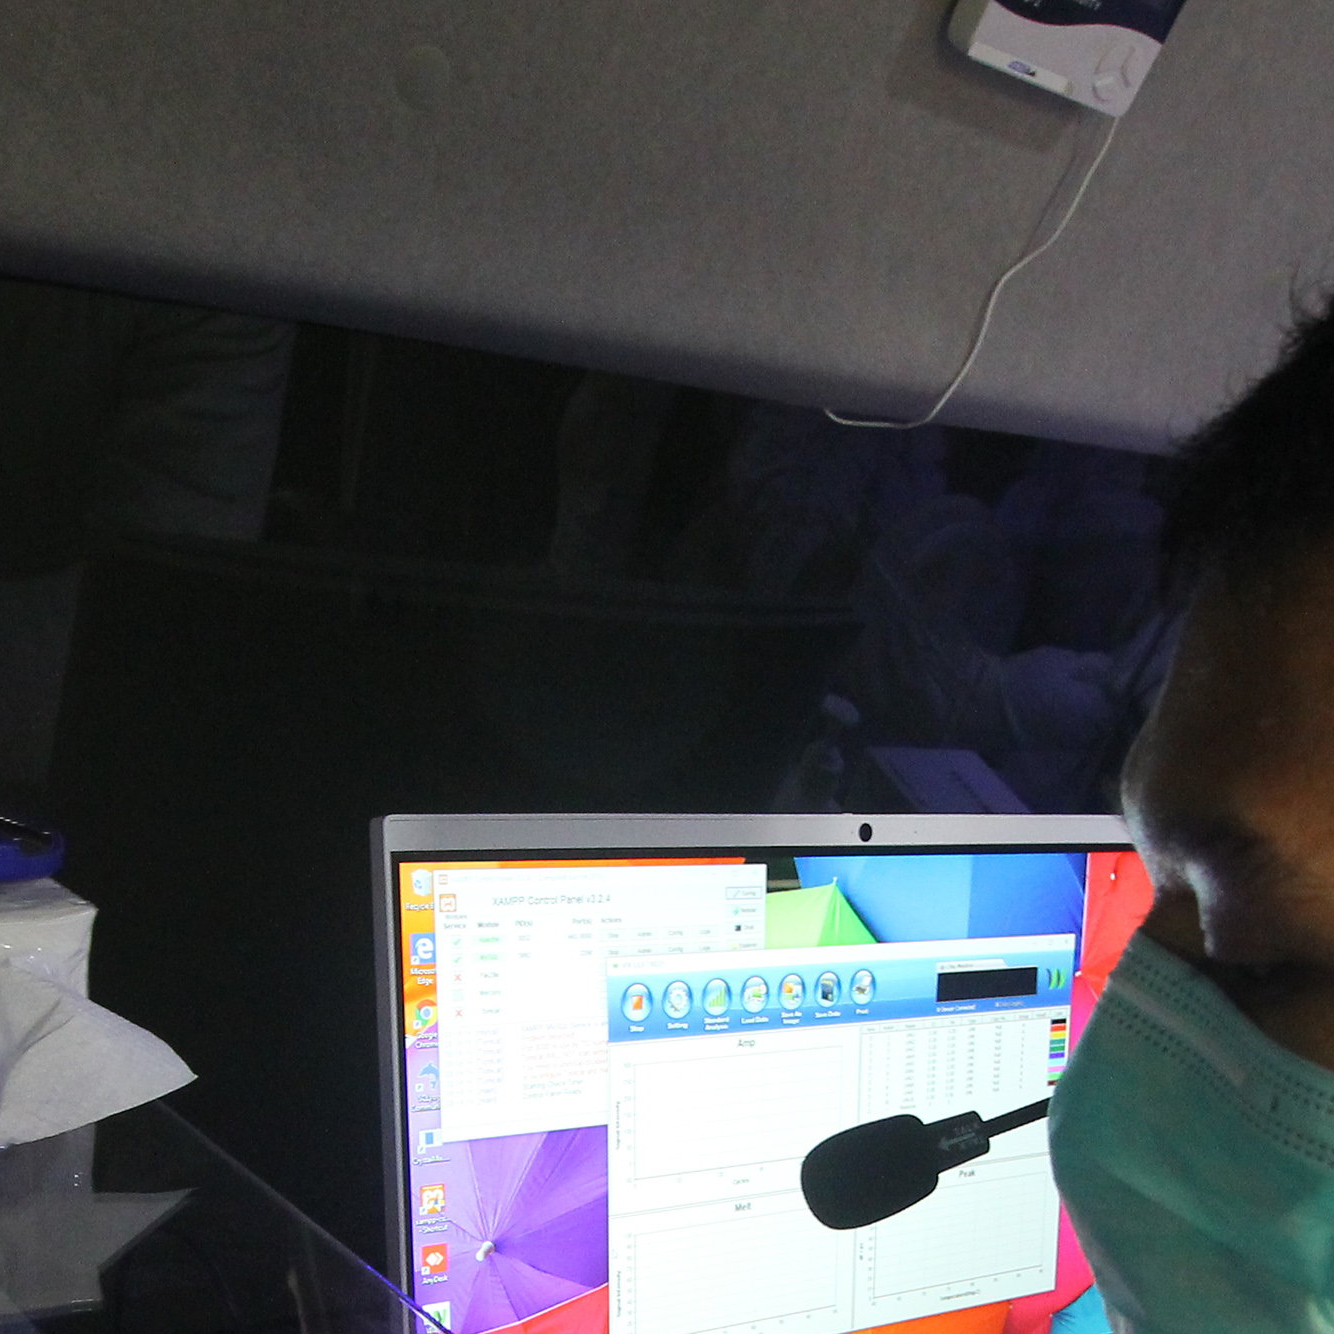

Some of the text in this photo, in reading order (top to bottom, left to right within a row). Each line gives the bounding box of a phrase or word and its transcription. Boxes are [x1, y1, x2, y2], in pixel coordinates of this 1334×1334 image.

[492, 895, 525, 906] XAMPP
[527, 895, 559, 905] Control
[560, 894, 584, 904] Panel
[736, 1038, 757, 1049] Amp
[734, 1202, 752, 1212] Melt
